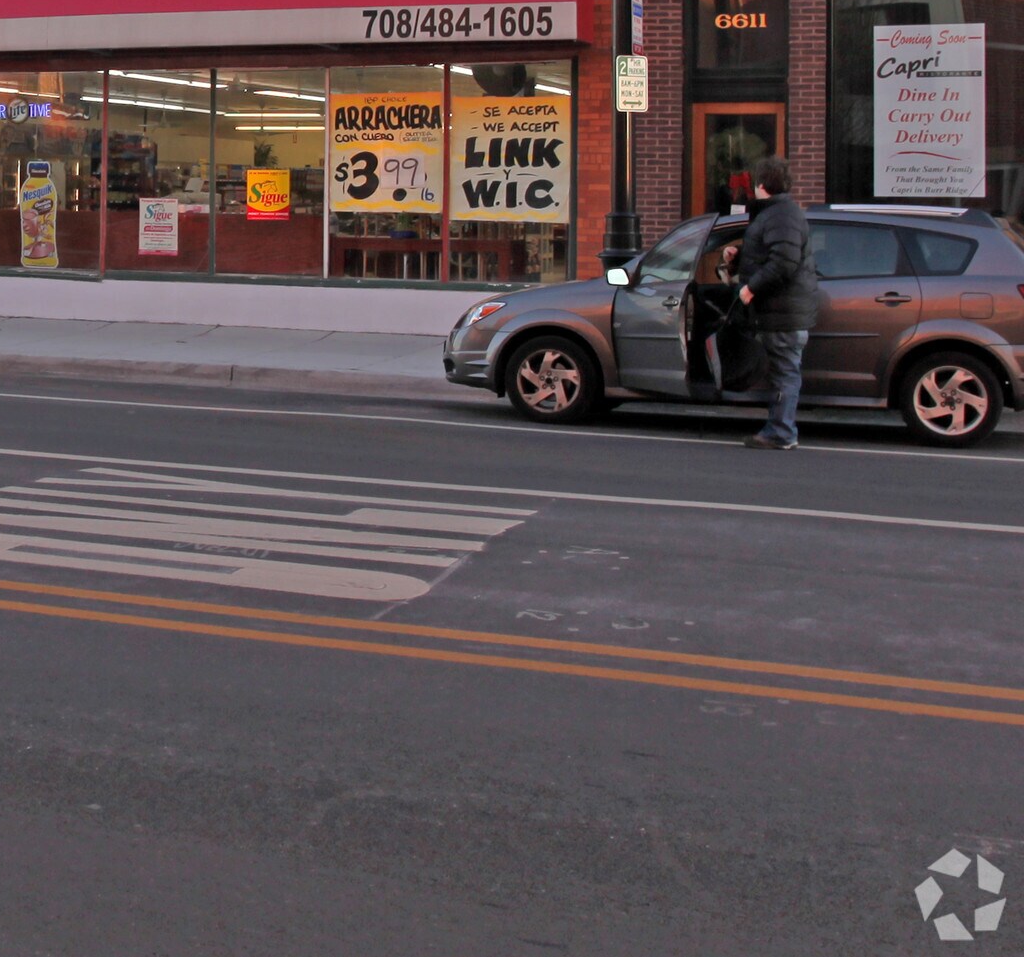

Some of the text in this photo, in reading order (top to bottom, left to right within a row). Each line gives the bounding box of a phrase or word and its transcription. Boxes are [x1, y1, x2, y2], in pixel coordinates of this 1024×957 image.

[362, 5, 553, 39] 708/484-1605
[714, 13, 768, 28] 6611
[890, 30, 967, 49] Coming Soon
[620, 60, 627, 74] 2
[634, 60, 641, 68] HR
[877, 51, 940, 80] Capri
[898, 88, 960, 102] Dine In
[28, 103, 51, 118] TIME
[335, 104, 442, 132] ARRACHERA
[483, 105, 557, 116] SE ACEPTA
[888, 108, 972, 125] Carry Out
[483, 122, 560, 133] WE ACCEPT
[335, 132, 394, 142] CON CUERO
[895, 129, 964, 146] Delivery
[464, 137, 564, 168] LINK
[504, 169, 511, 180] Y
[946, 166, 974, 174] Family
[916, 176, 948, 185] Brought
[23, 184, 53, 201] Nesquik
[249, 182, 288, 207] Sigue
[462, 180, 560, 208] W.I.C.
[891, 187, 912, 195] Capri
[945, 186, 968, 194] Ridge
[144, 204, 173, 222] Sigue
